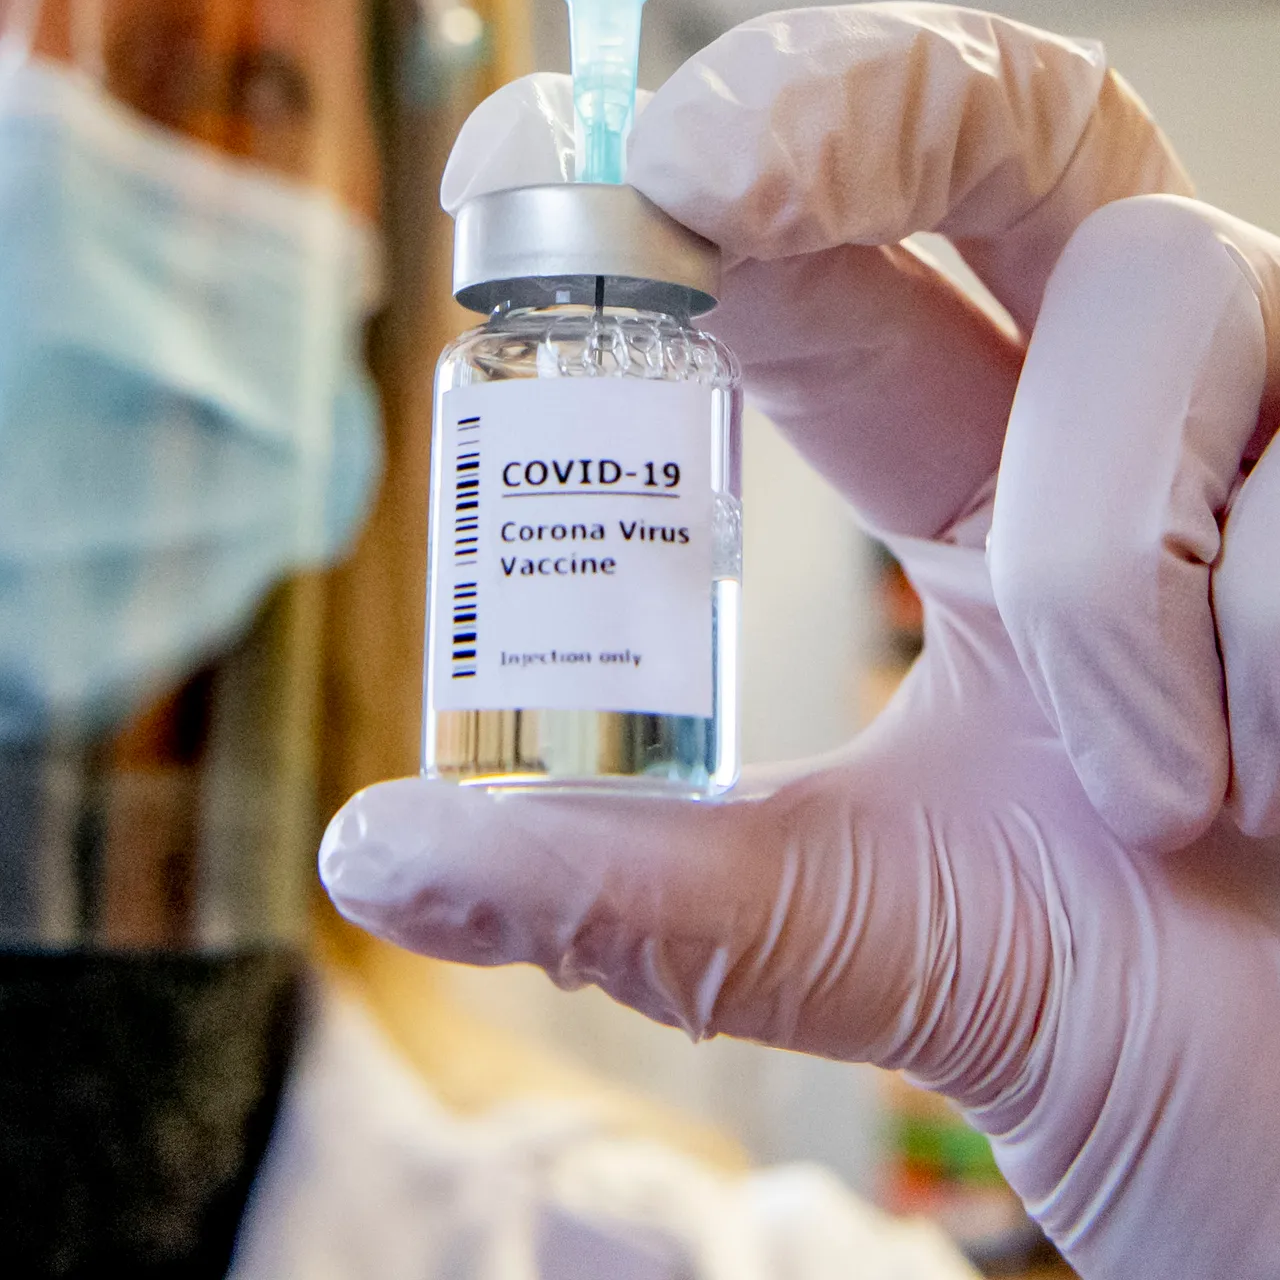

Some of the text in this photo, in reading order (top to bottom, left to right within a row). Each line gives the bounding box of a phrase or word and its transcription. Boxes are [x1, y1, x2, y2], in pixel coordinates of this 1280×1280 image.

[502, 459, 681, 488] COVID-19
[500, 519, 690, 544] Corona Virus
[500, 553, 617, 577] Vaccine
[500, 648, 642, 668] Injection only
